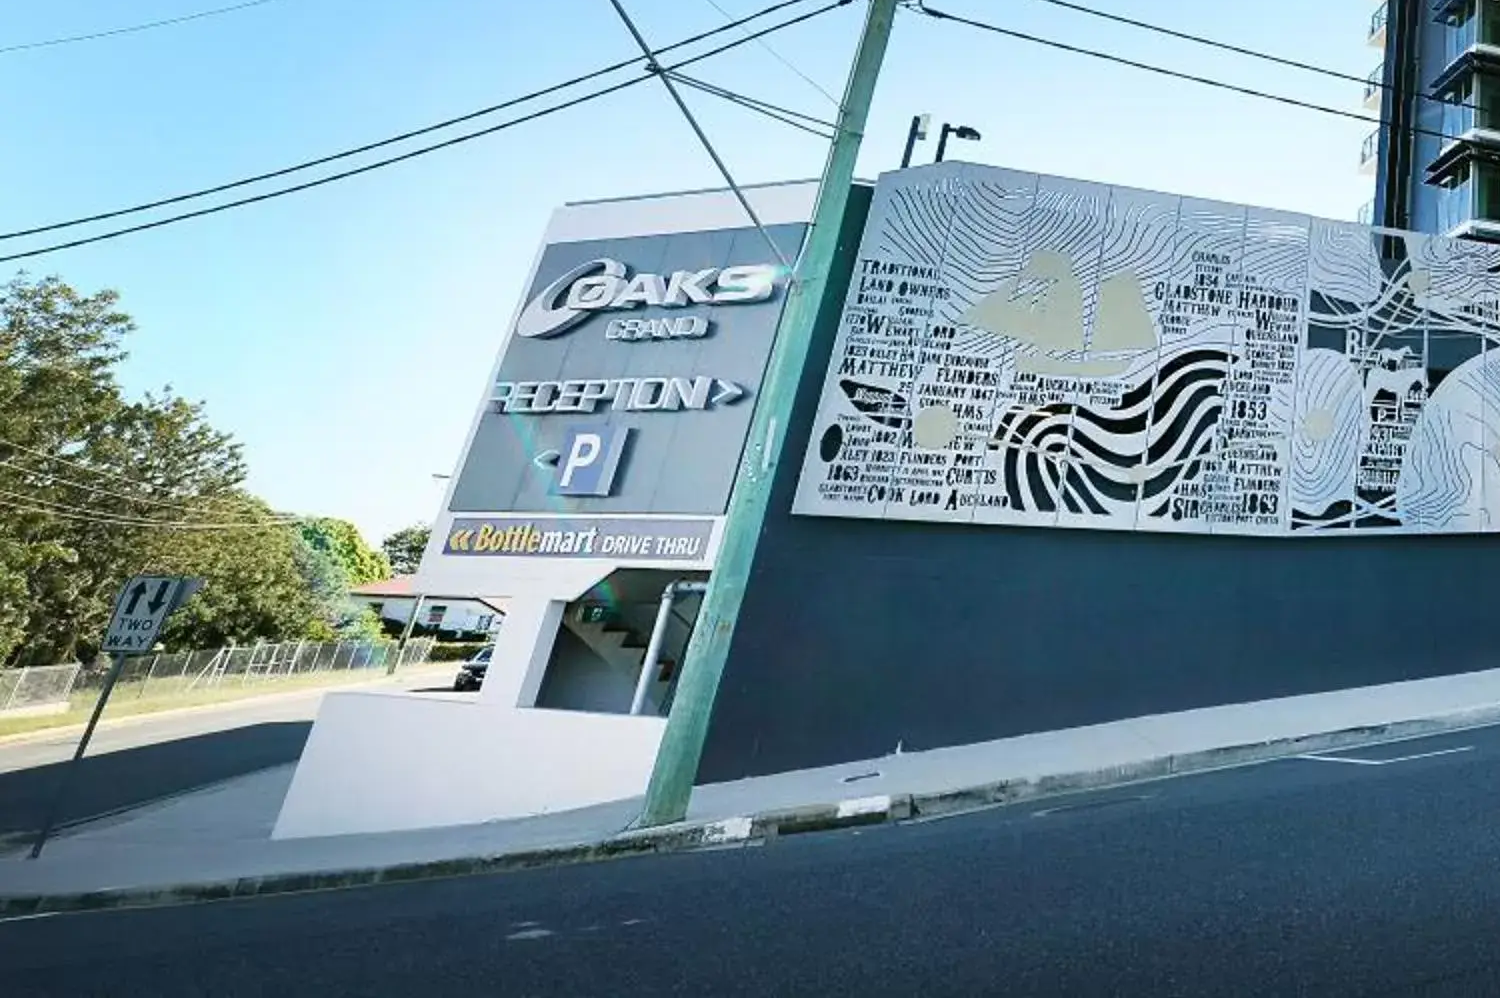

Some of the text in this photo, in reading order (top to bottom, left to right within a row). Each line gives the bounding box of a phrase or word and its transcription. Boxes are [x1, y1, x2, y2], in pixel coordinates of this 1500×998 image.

[861, 259, 941, 280] TRADITIONAL
[563, 258, 773, 310] OAKS
[859, 276, 951, 300] LAND OWNERS
[1155, 281, 1233, 305] GLADSTONE
[1239, 290, 1299, 313] HARBOUR
[1163, 299, 1221, 317] MATTHEW
[605, 316, 709, 340] GRAND
[838, 357, 999, 386] MATTHEW FLINDERS
[489, 376, 711, 413] RECEPTION
[917, 383, 969, 399] JANUARY
[1230, 400, 1267, 421] 1853
[559, 433, 601, 488] P
[900, 451, 948, 465] FLINDERS
[827, 464, 860, 482] 1863
[945, 468, 998, 486] CURTIS
[909, 490, 941, 507] LORD
[944, 490, 1009, 510] AUCKLAND
[1171, 498, 1199, 521] SIR
[1241, 493, 1279, 514] 1863
[474, 522, 700, 556] Bottlemart DRIVE THRU
[120, 617, 153, 631] TWO
[107, 635, 149, 648] WAY
